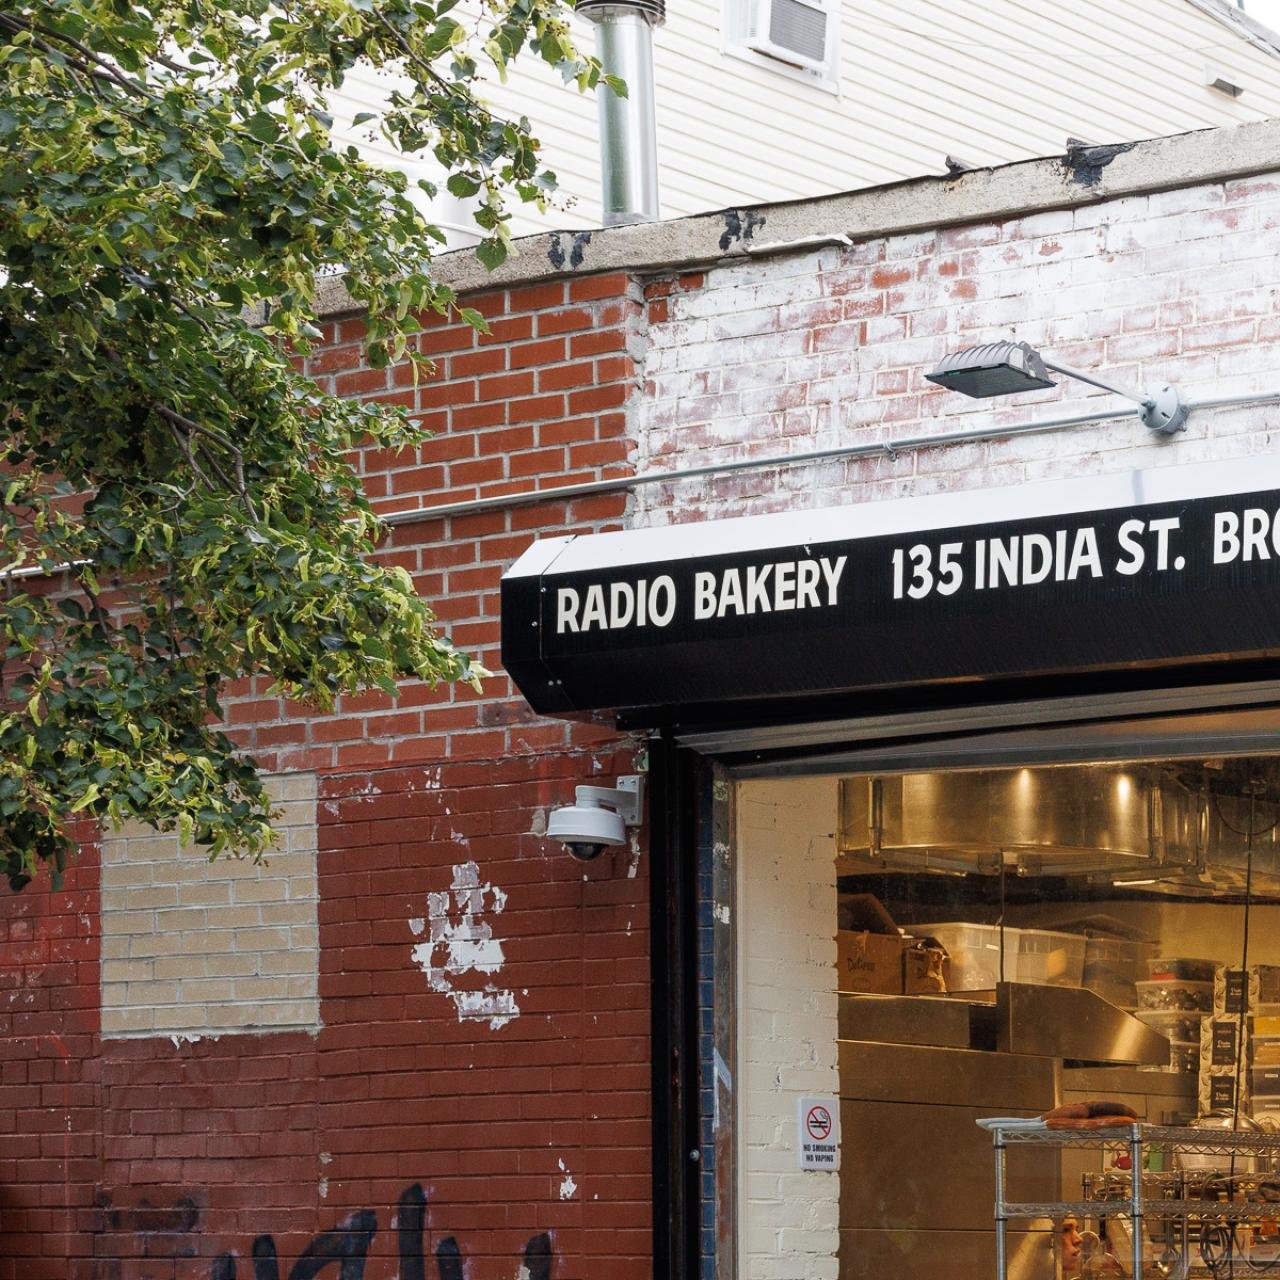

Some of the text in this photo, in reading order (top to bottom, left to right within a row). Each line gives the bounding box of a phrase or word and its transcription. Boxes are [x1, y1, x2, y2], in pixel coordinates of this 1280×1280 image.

[556, 574, 677, 635] RADIO
[694, 556, 848, 620] BAKERY
[891, 543, 964, 600] 135
[975, 527, 1104, 590] INDIA
[1115, 517, 1186, 576] ST.
[803, 1144, 836, 1153] NO SMOKING
[805, 1154, 834, 1163] NO VAPING
